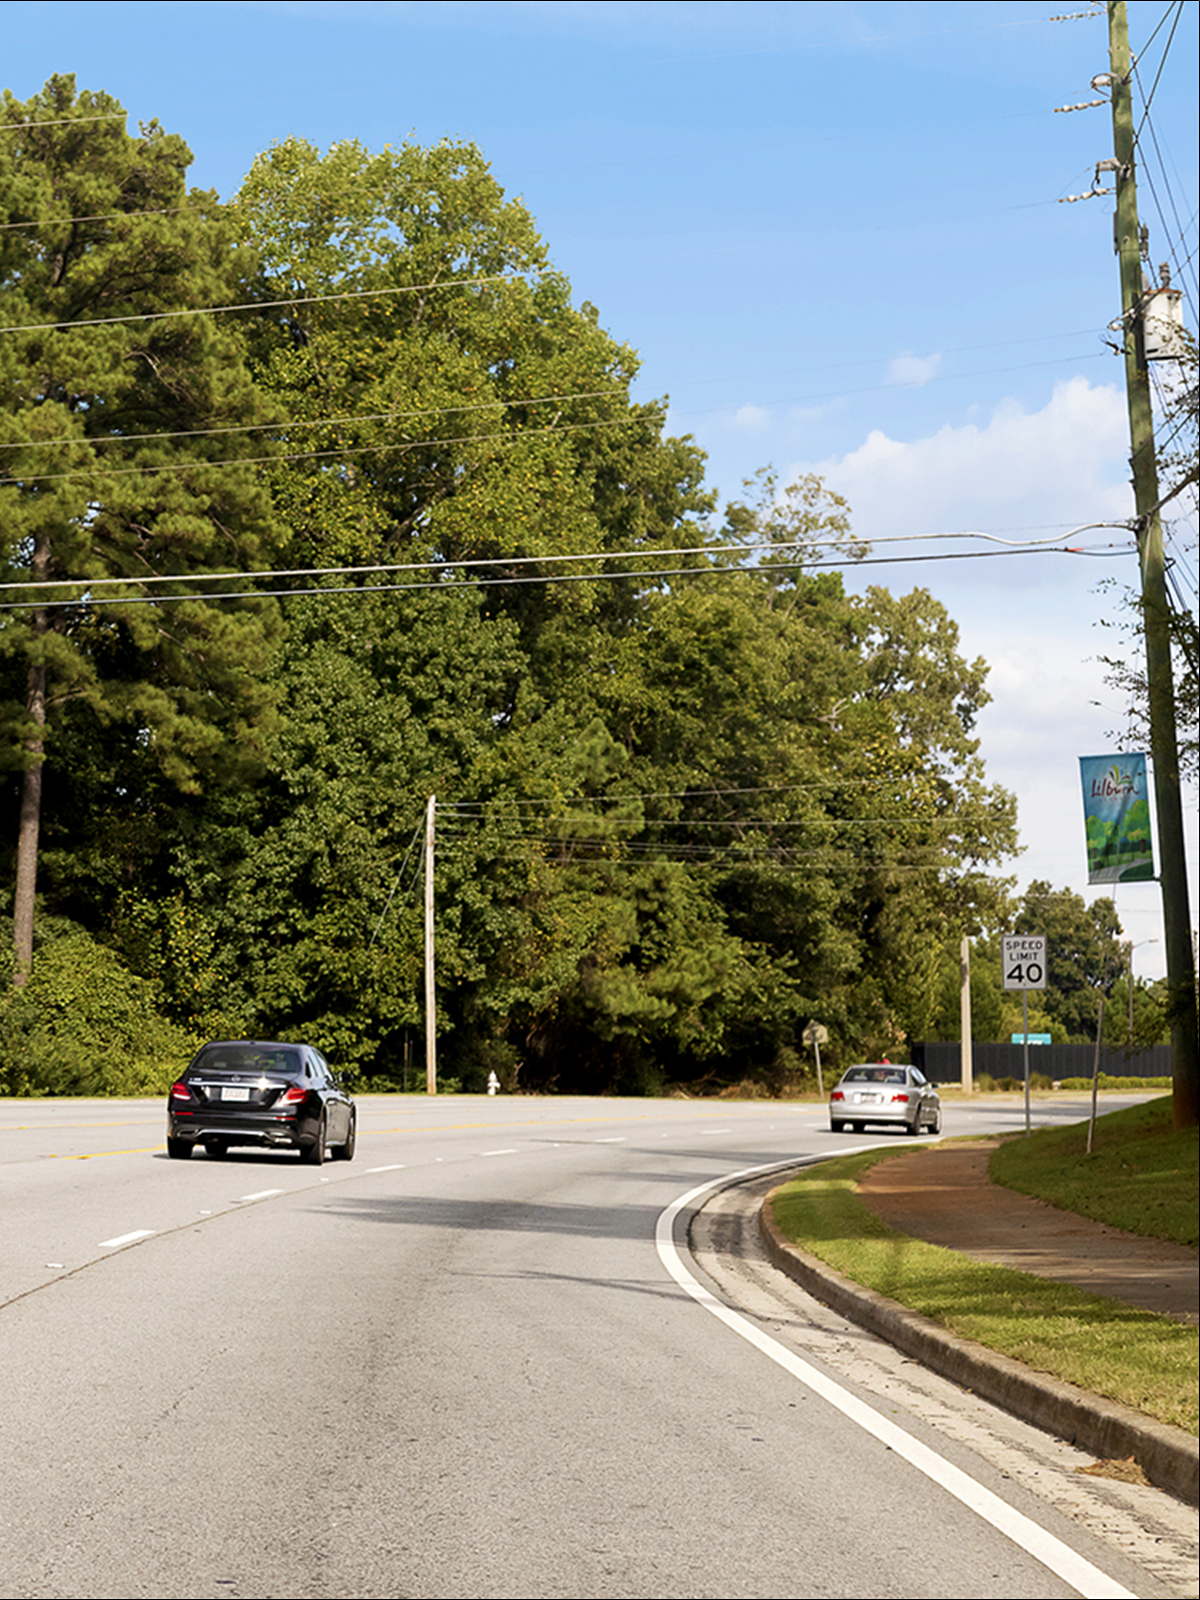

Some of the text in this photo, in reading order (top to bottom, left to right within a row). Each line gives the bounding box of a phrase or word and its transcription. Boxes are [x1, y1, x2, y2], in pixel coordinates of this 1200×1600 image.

[1091, 778, 1140, 798] Lilburn
[1005, 940, 1043, 951] SPEED
[1009, 952, 1039, 961] LIMIT
[1006, 963, 1043, 983] 40
